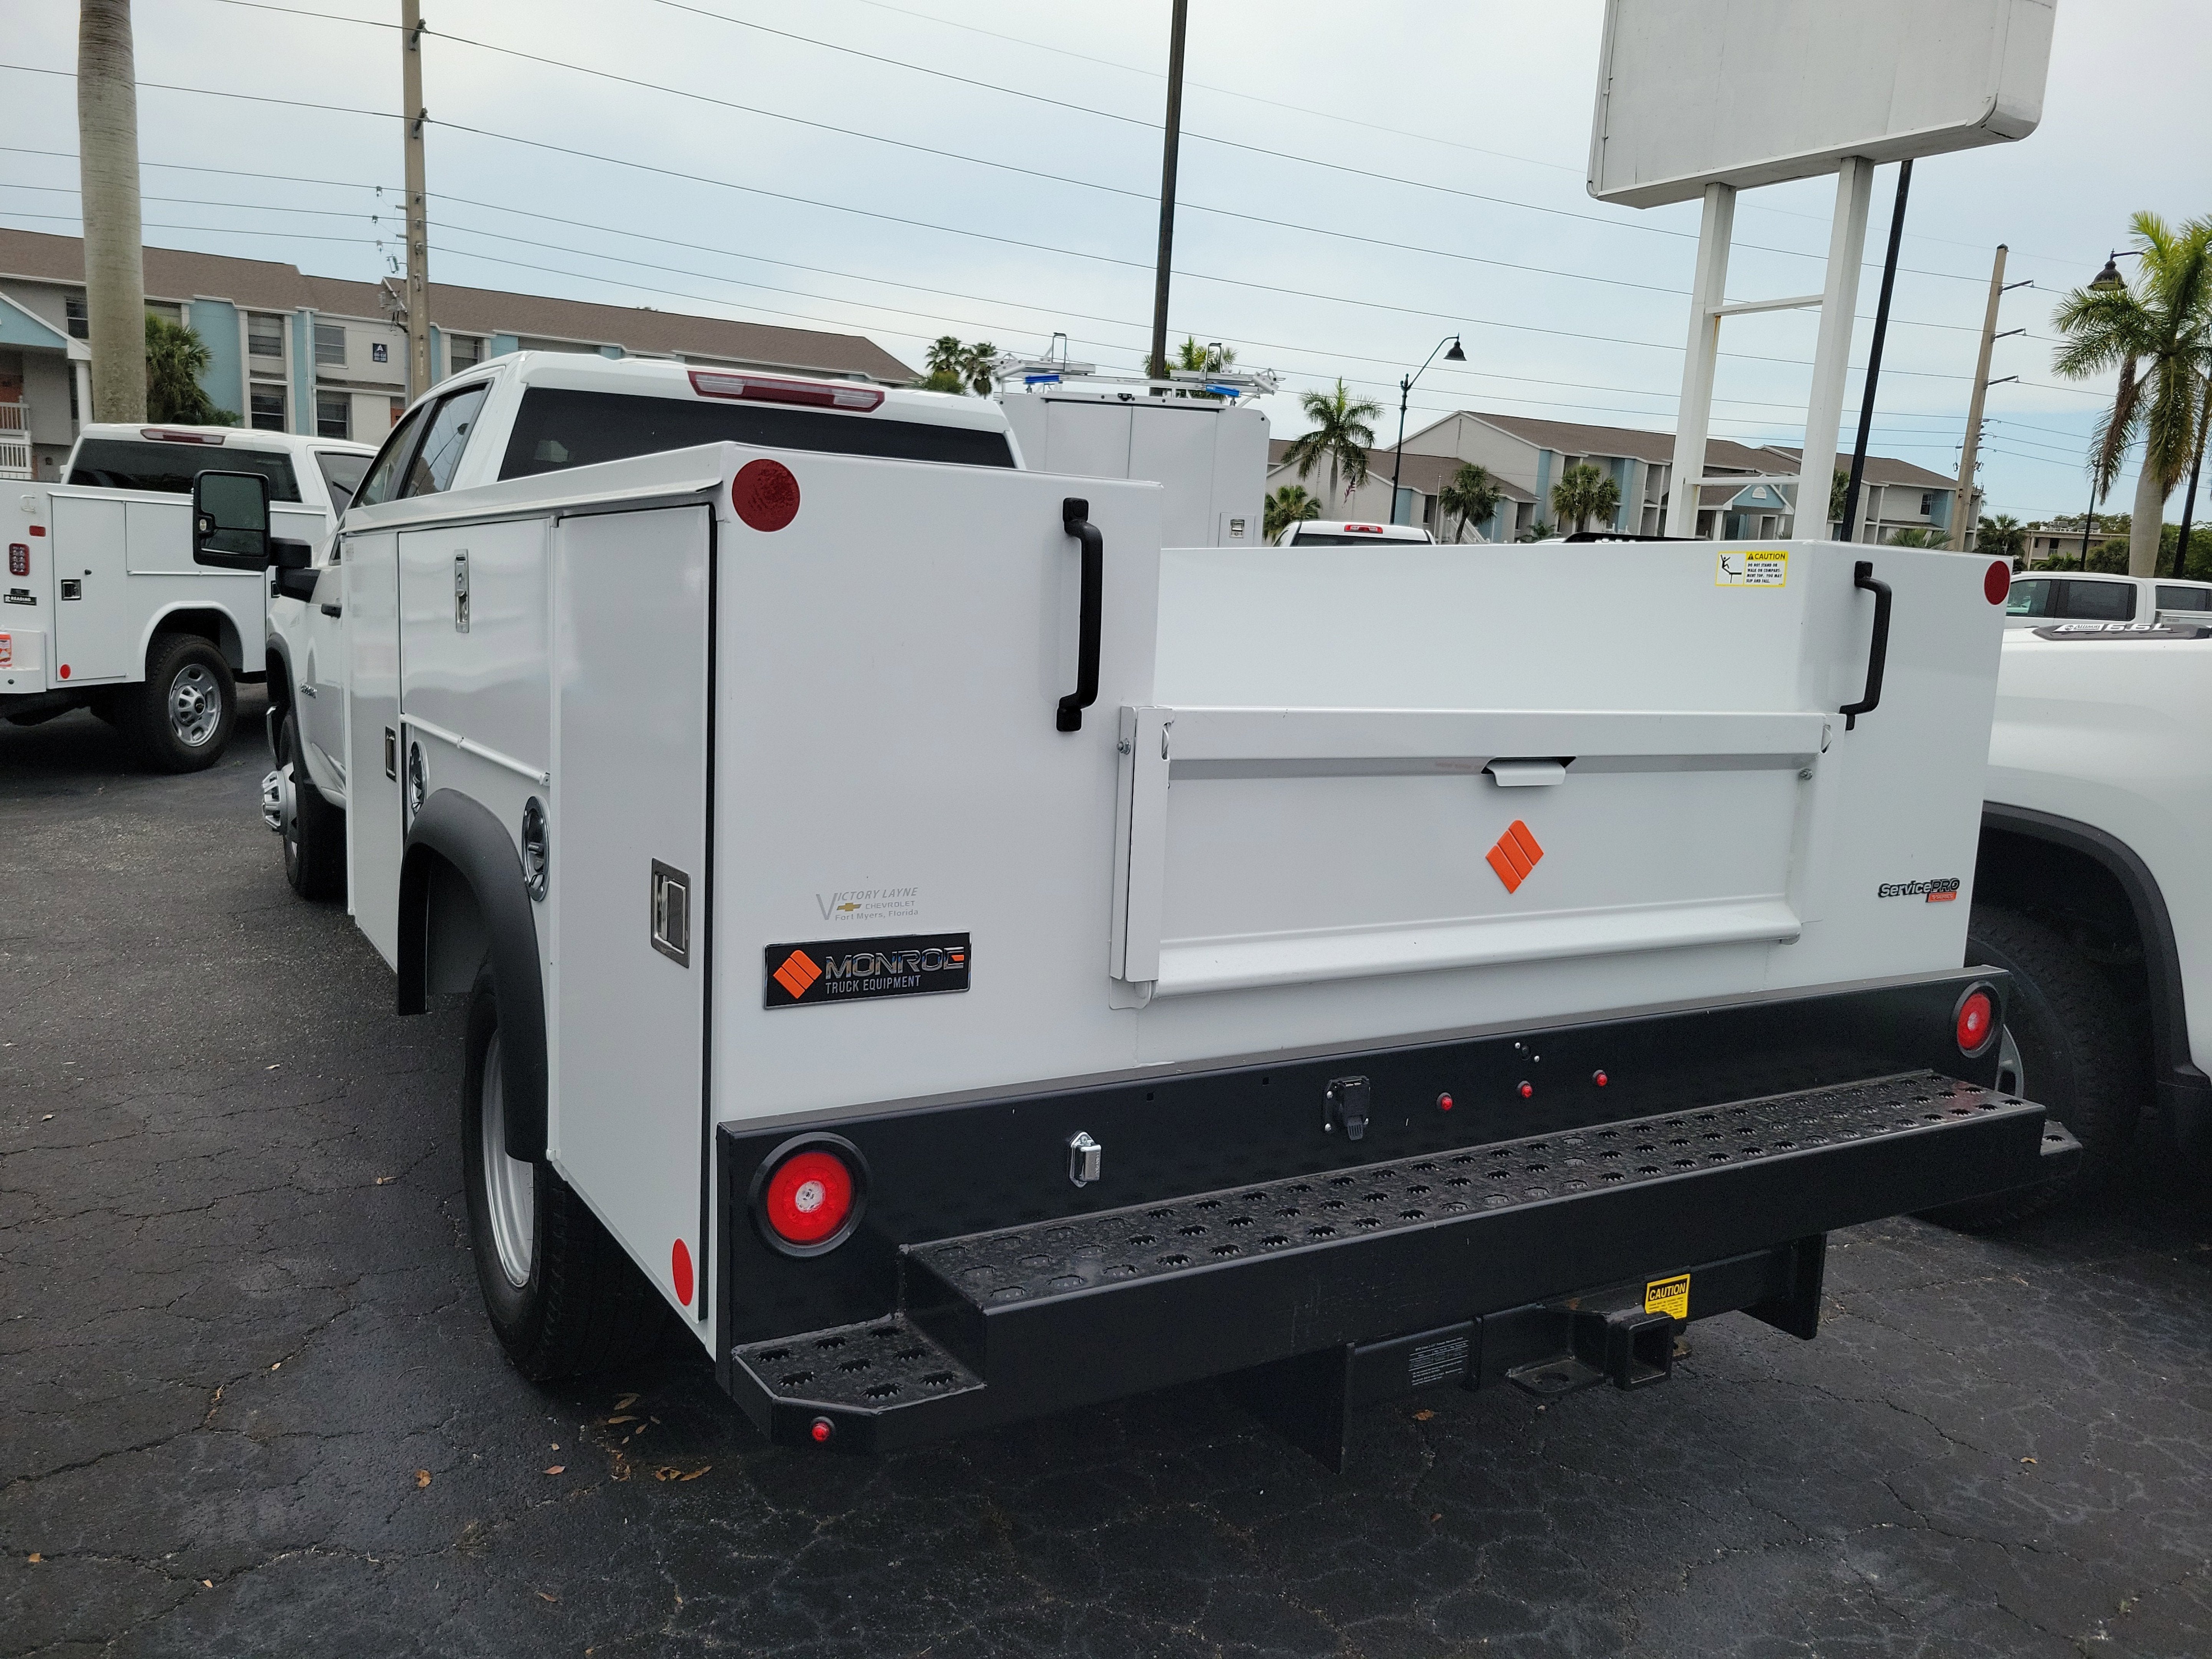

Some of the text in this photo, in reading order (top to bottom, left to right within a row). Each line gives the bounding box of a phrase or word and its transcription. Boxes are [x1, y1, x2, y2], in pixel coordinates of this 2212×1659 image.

[2104, 623, 2171, 631] 6.6L
[1878, 878, 1960, 897] ServicePRO
[816, 887, 918, 920] VICTORY LAYNE
[866, 901, 916, 909] CHEVROLET
[857, 911, 886, 920] Myers,
[825, 947, 964, 980] MONROE
[826, 975, 921, 994] TRUCK EQUIPMENT
[1649, 1283, 1686, 1300] CAUTION
